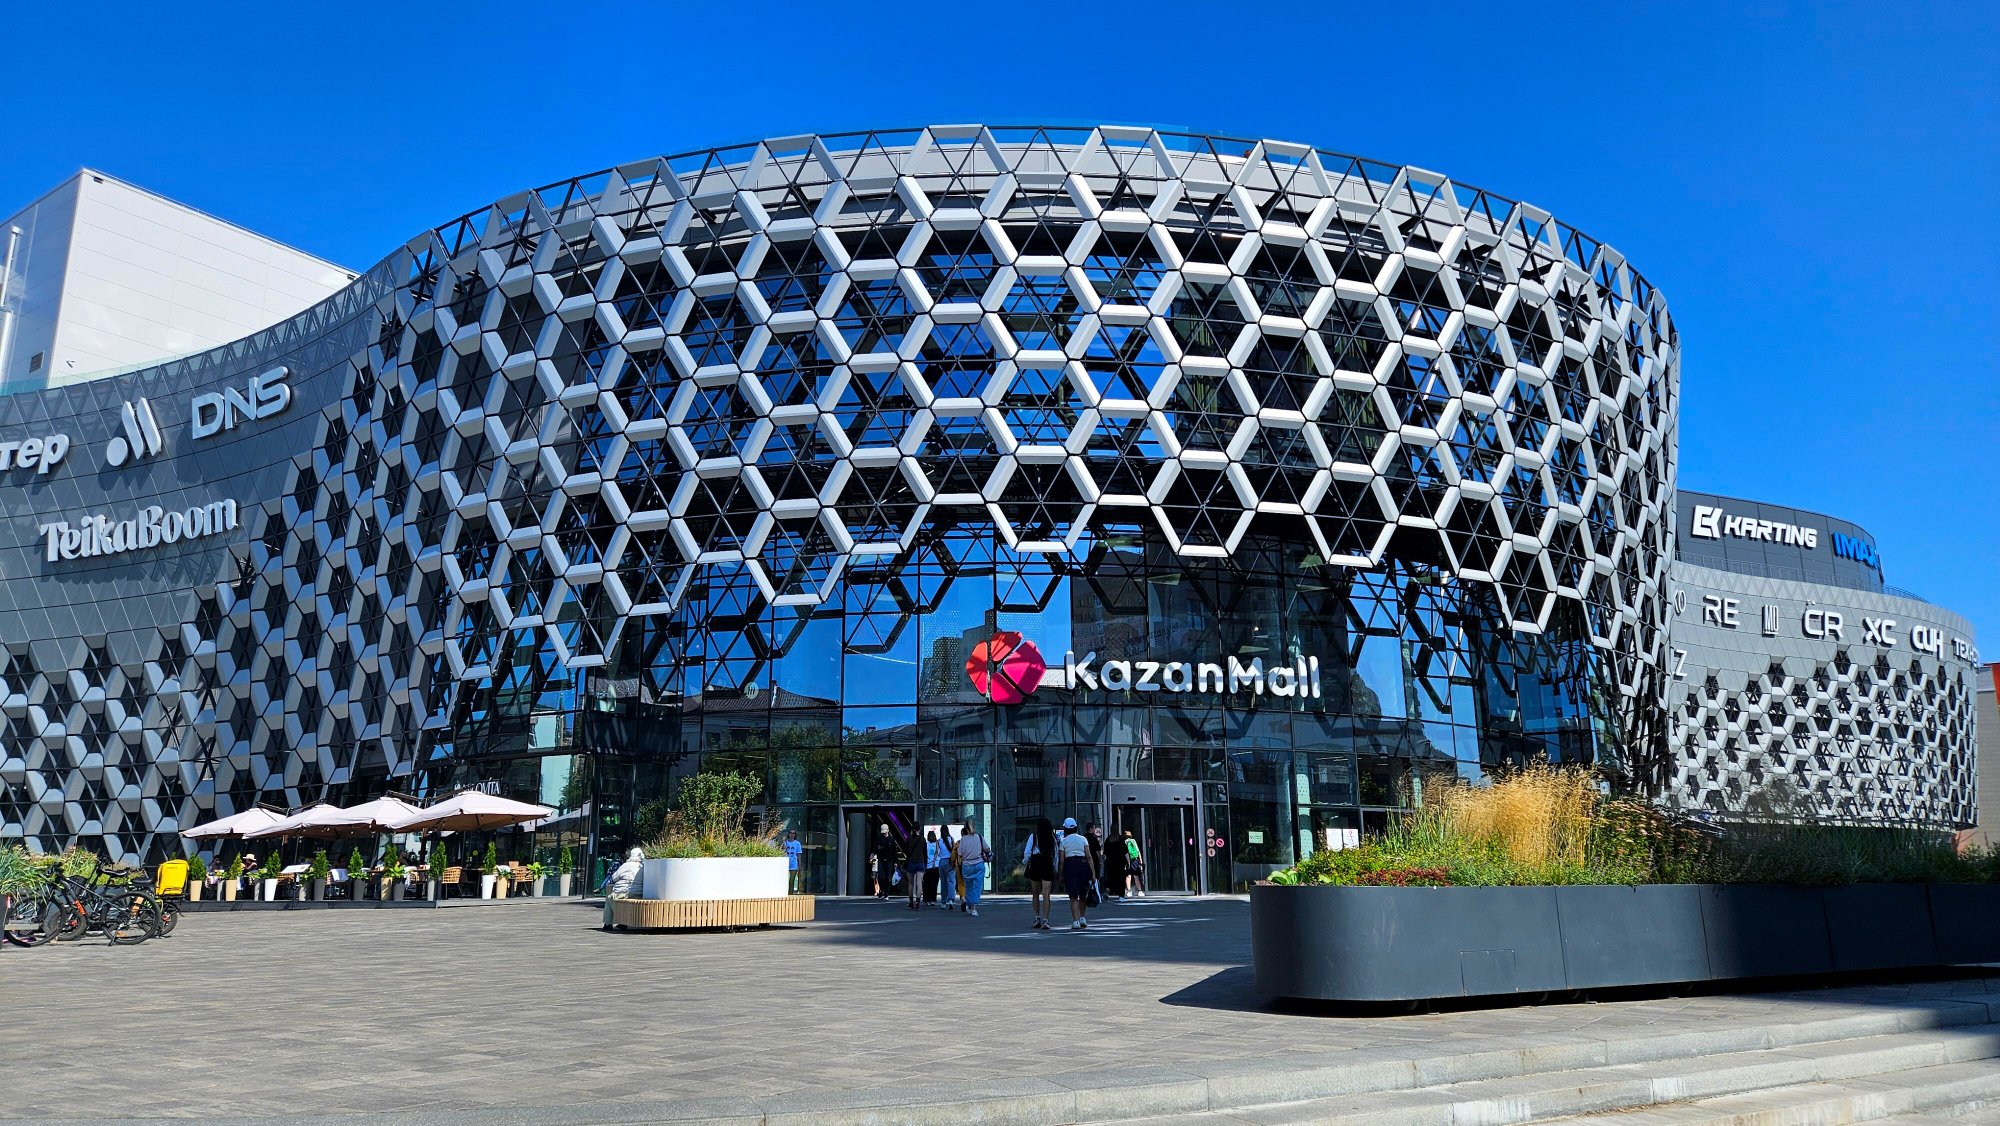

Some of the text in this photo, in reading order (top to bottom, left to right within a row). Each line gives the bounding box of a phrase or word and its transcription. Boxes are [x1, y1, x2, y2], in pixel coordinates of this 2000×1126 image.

[192, 366, 291, 440] DNS
[1723, 514, 1818, 548] KARTING
[1705, 594, 1740, 626] RE
[1065, 650, 1321, 699] KazanMall
